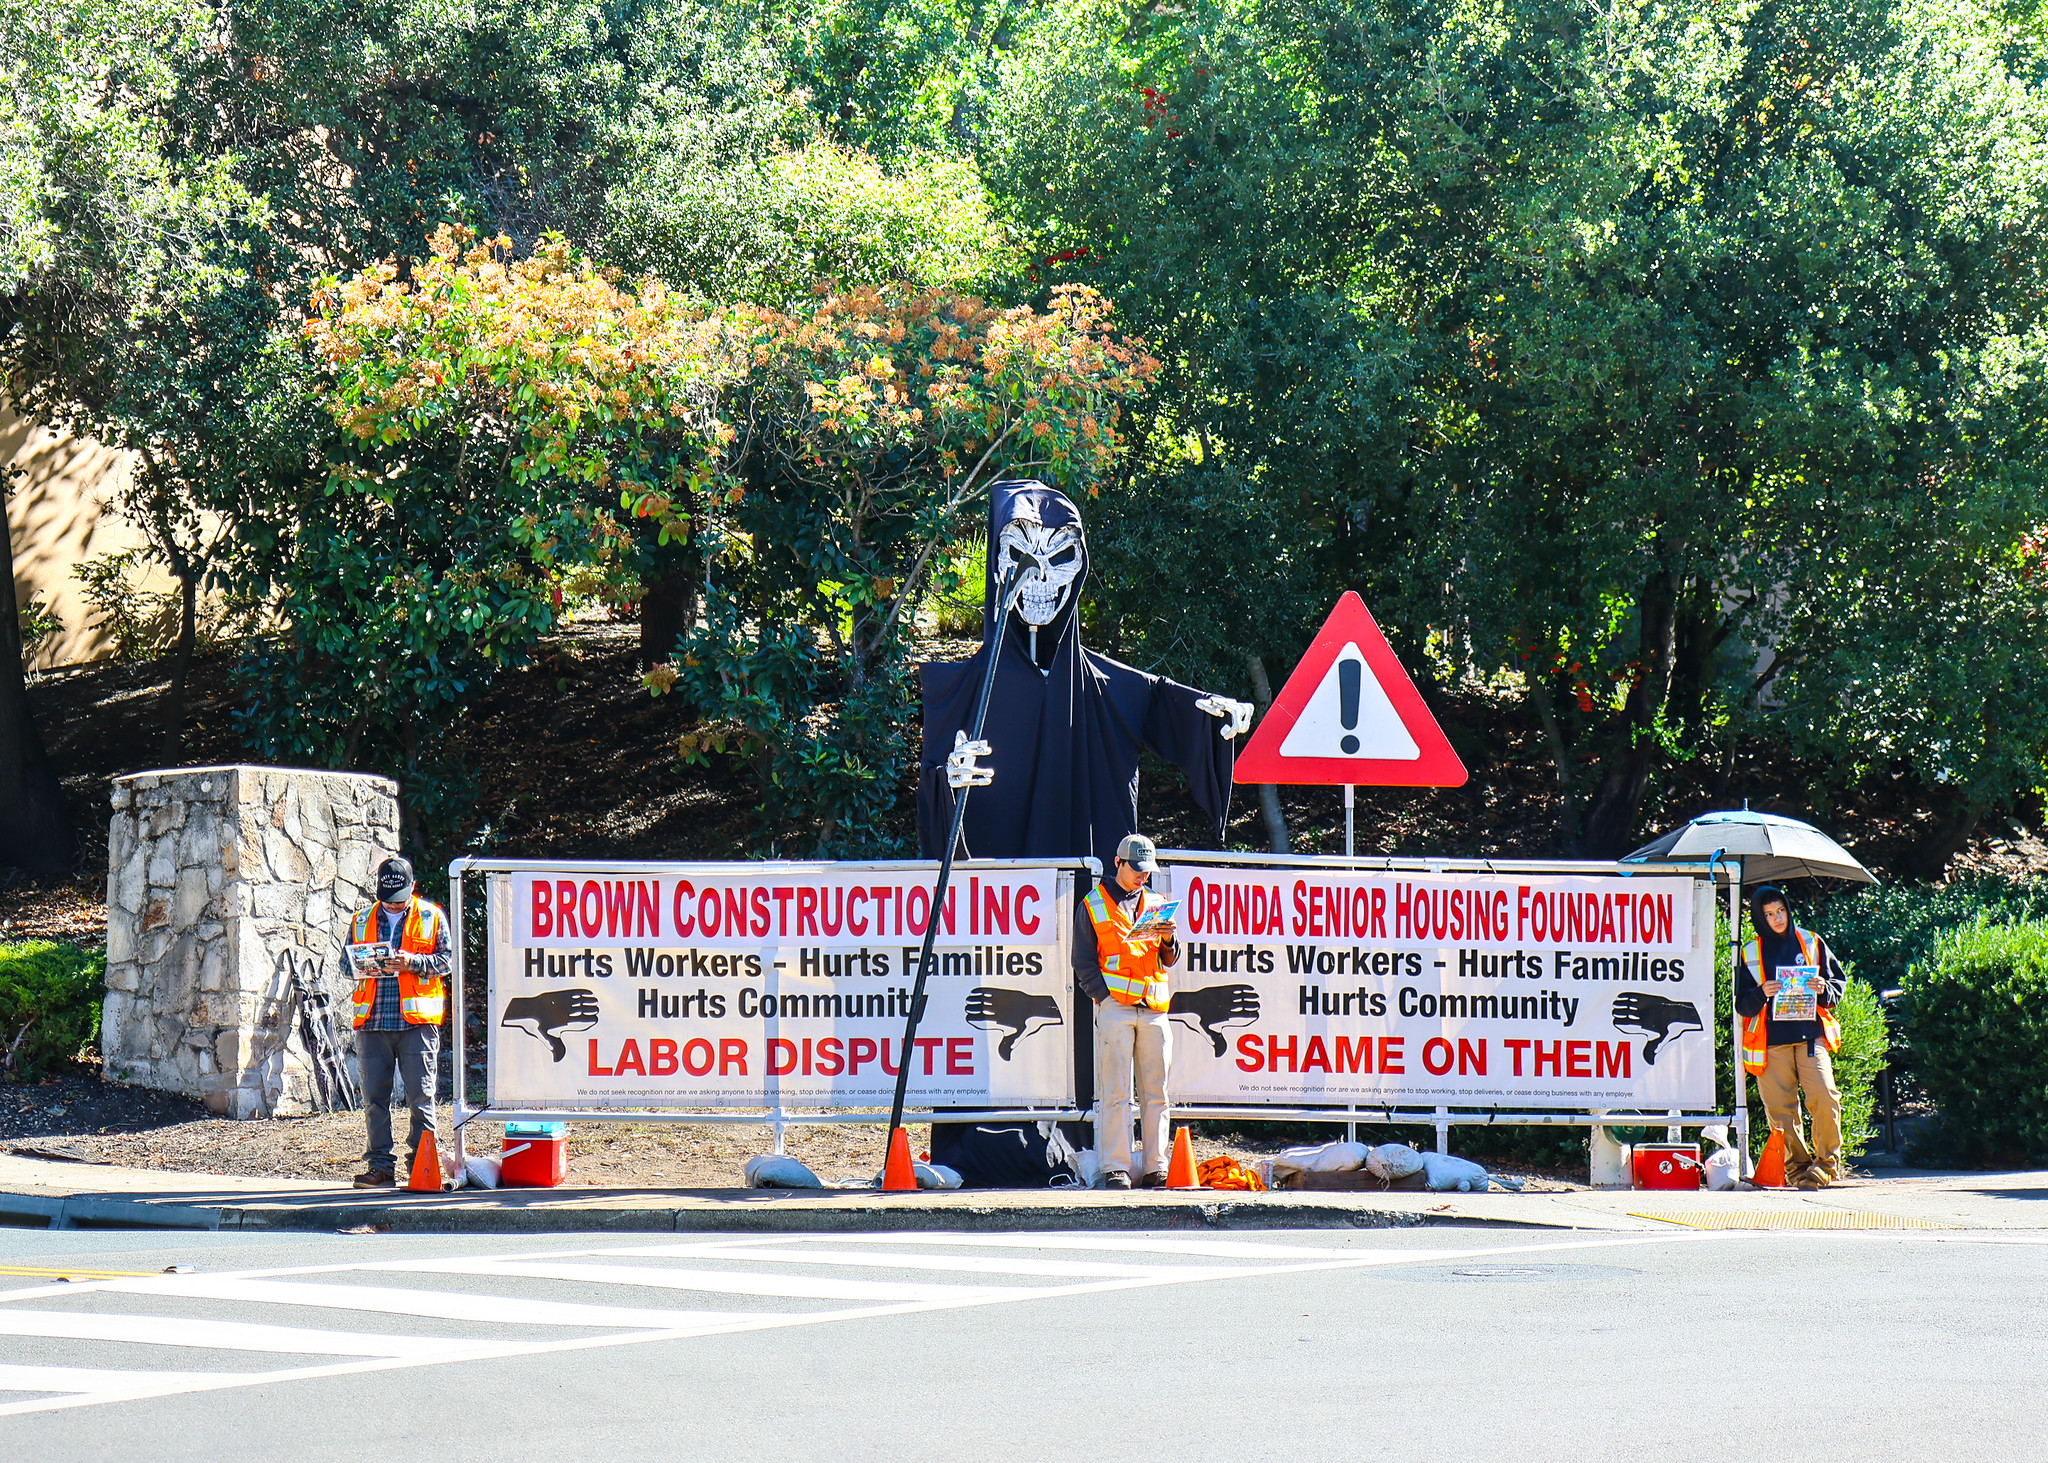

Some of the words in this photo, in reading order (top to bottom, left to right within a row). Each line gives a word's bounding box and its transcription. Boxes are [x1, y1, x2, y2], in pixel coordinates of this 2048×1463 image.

[532, 880, 660, 938] BROWN
[673, 879, 957, 938] CONSTRUCTION
[970, 877, 1041, 936] INC
[1188, 876, 1285, 936] ORINDA
[1292, 879, 1387, 939] SENIOR
[1397, 882, 1508, 942] HOUSING
[1517, 885, 1673, 944] FOUNDATION
[525, 947, 612, 977] Hurts
[625, 947, 762, 978] Workers
[800, 947, 890, 977] Hurts
[902, 945, 1043, 977] Families
[1187, 943, 1274, 974] Hurts
[1286, 945, 1422, 977] Workers
[1459, 948, 1543, 979] Hurts
[1555, 950, 1685, 982] Families
[638, 988, 726, 1019] Hurts
[1299, 985, 1387, 1017] Hurts
[1399, 986, 1579, 1027] Community
[588, 1037, 749, 1077] LABOR
[767, 1036, 975, 1077] DISPUTE
[1235, 1033, 1406, 1075] SHAME
[1423, 1036, 1488, 1076] ON
[1504, 1038, 1632, 1079] THEM
[754, 1088, 769, 1096] stop
[770, 1088, 797, 1096] working,
[799, 1088, 813, 1096] stop
[815, 1088, 847, 1096] deliveries,
[957, 1088, 988, 1096] employer.
[1290, 1085, 1325, 1094] recognition
[1361, 1087, 1381, 1095] asking
[1415, 1087, 1429, 1095] stop
[1431, 1088, 1457, 1096] working,
[1459, 1088, 1473, 1096] stop
[1474, 1088, 1504, 1097] deliveries,
[1533, 1089, 1549, 1097] doing
[1551, 1089, 1578, 1097] business
[1605, 1090, 1635, 1099] employer.
